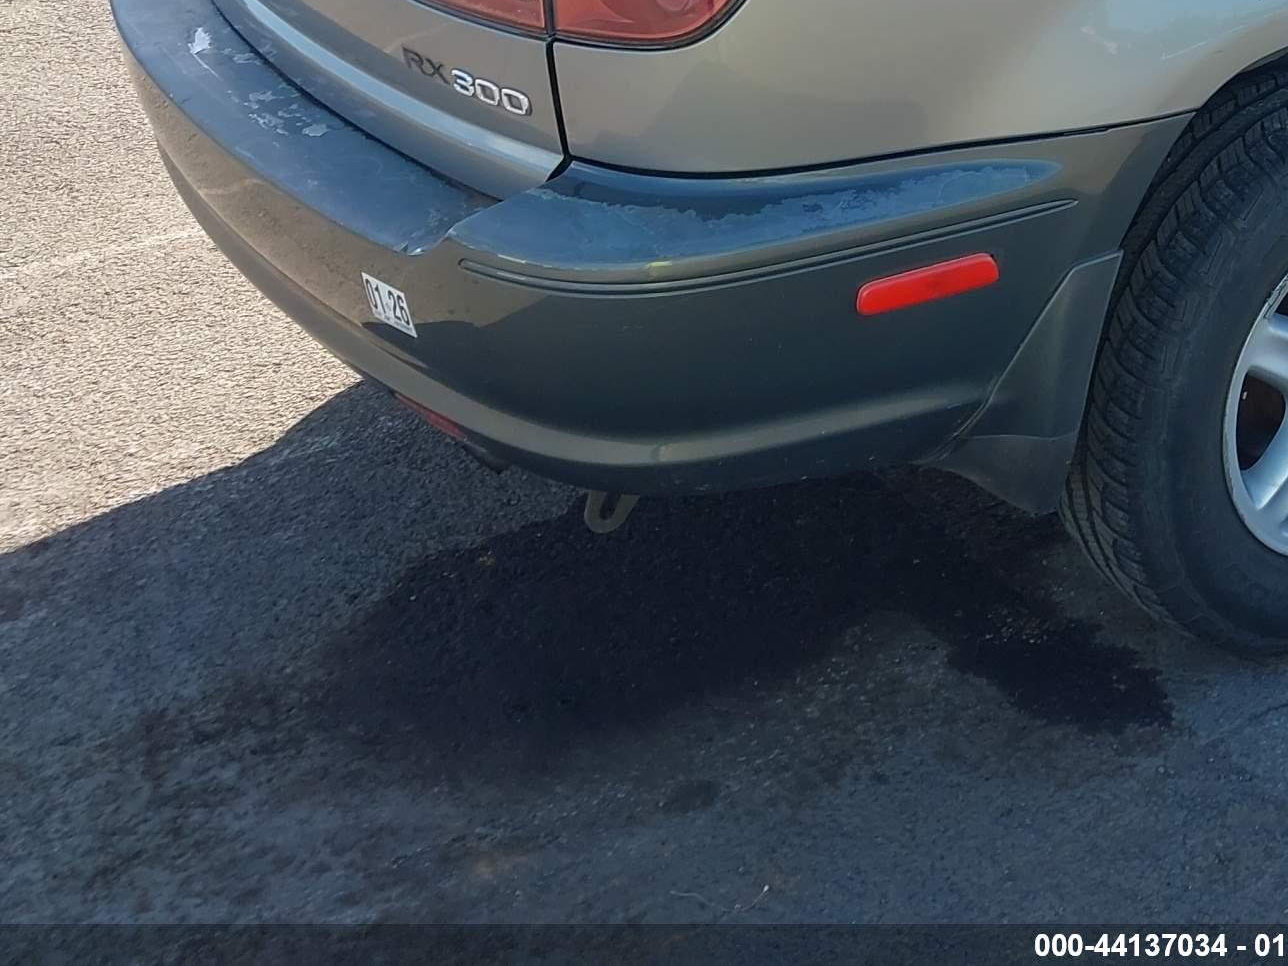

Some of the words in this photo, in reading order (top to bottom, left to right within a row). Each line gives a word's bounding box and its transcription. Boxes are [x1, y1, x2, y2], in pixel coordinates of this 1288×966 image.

[401, 46, 450, 85] RX
[450, 67, 533, 116] 300
[365, 278, 387, 314] 01
[387, 290, 410, 326] 26
